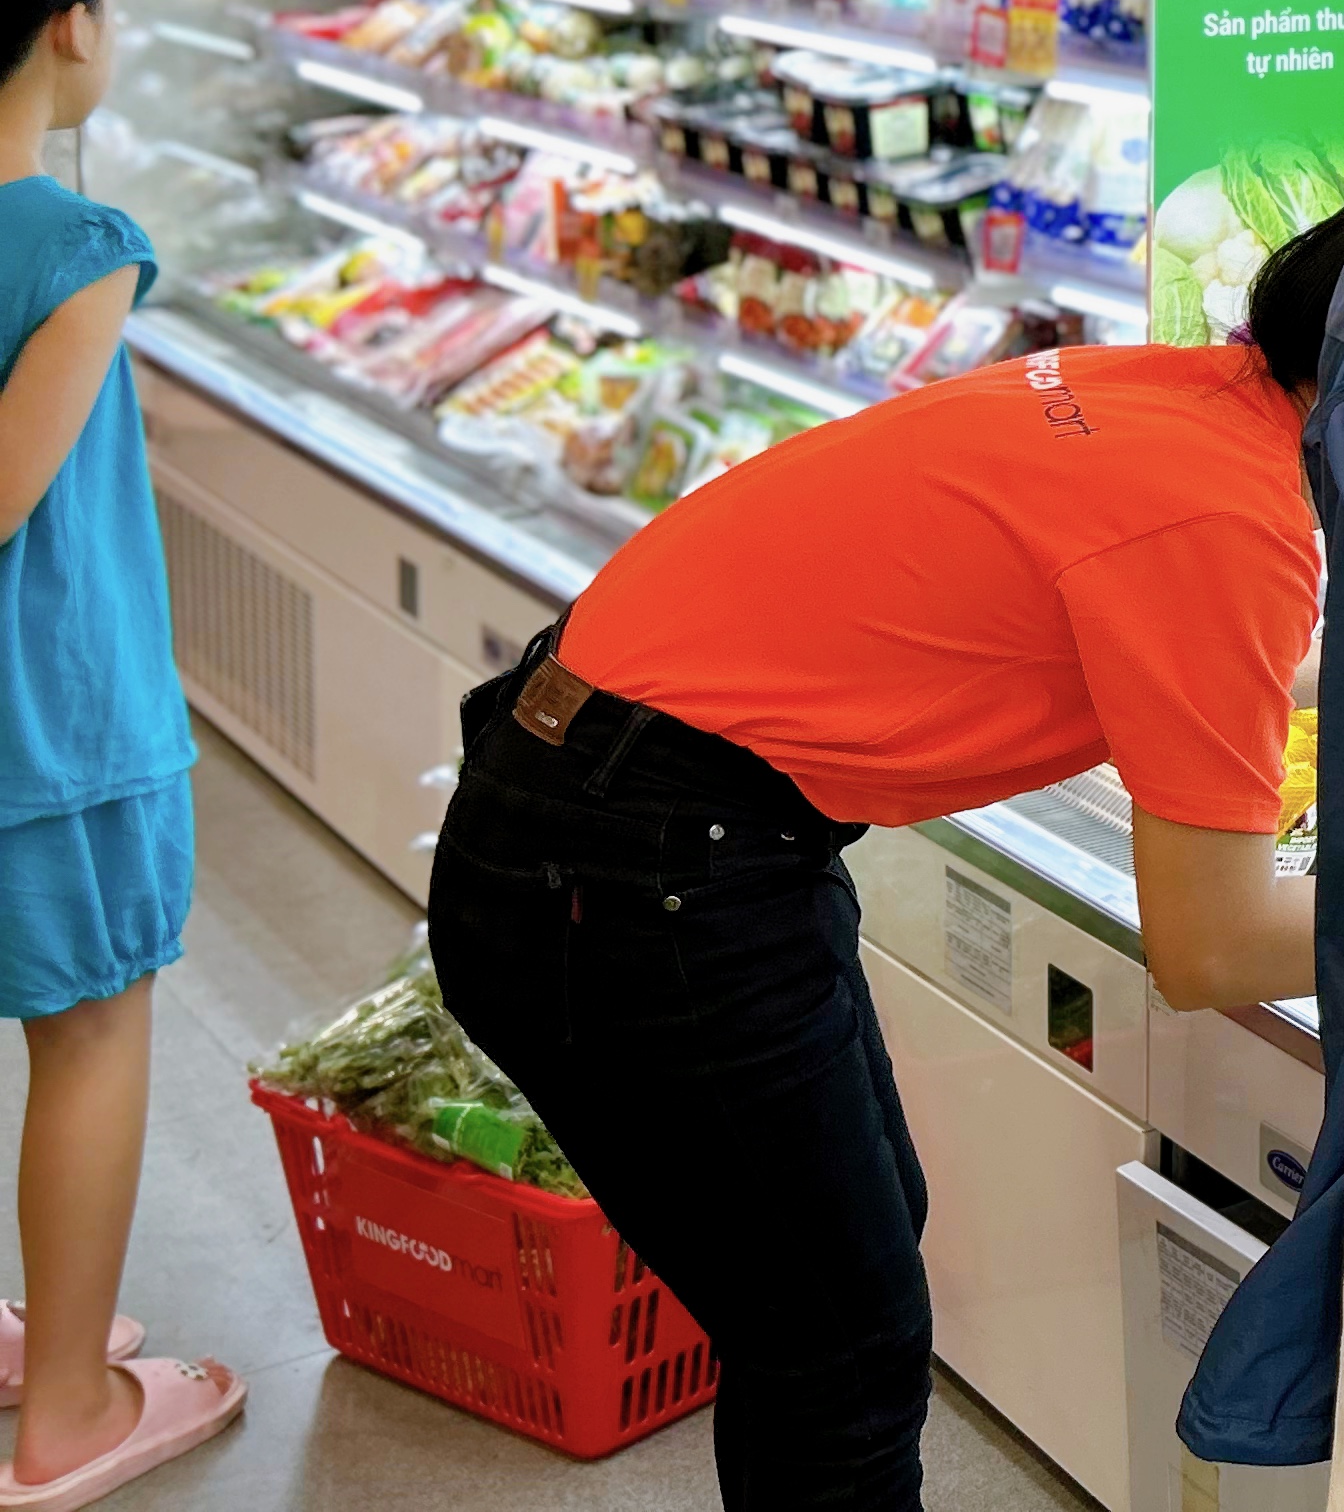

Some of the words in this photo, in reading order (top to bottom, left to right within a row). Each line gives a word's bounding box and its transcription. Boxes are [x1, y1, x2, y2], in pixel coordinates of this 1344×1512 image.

[1203, 9, 1246, 39] Sản
[1251, 7, 1310, 41] phẩm
[1246, 51, 1271, 78] tự
[1275, 46, 1334, 72] nhiên
